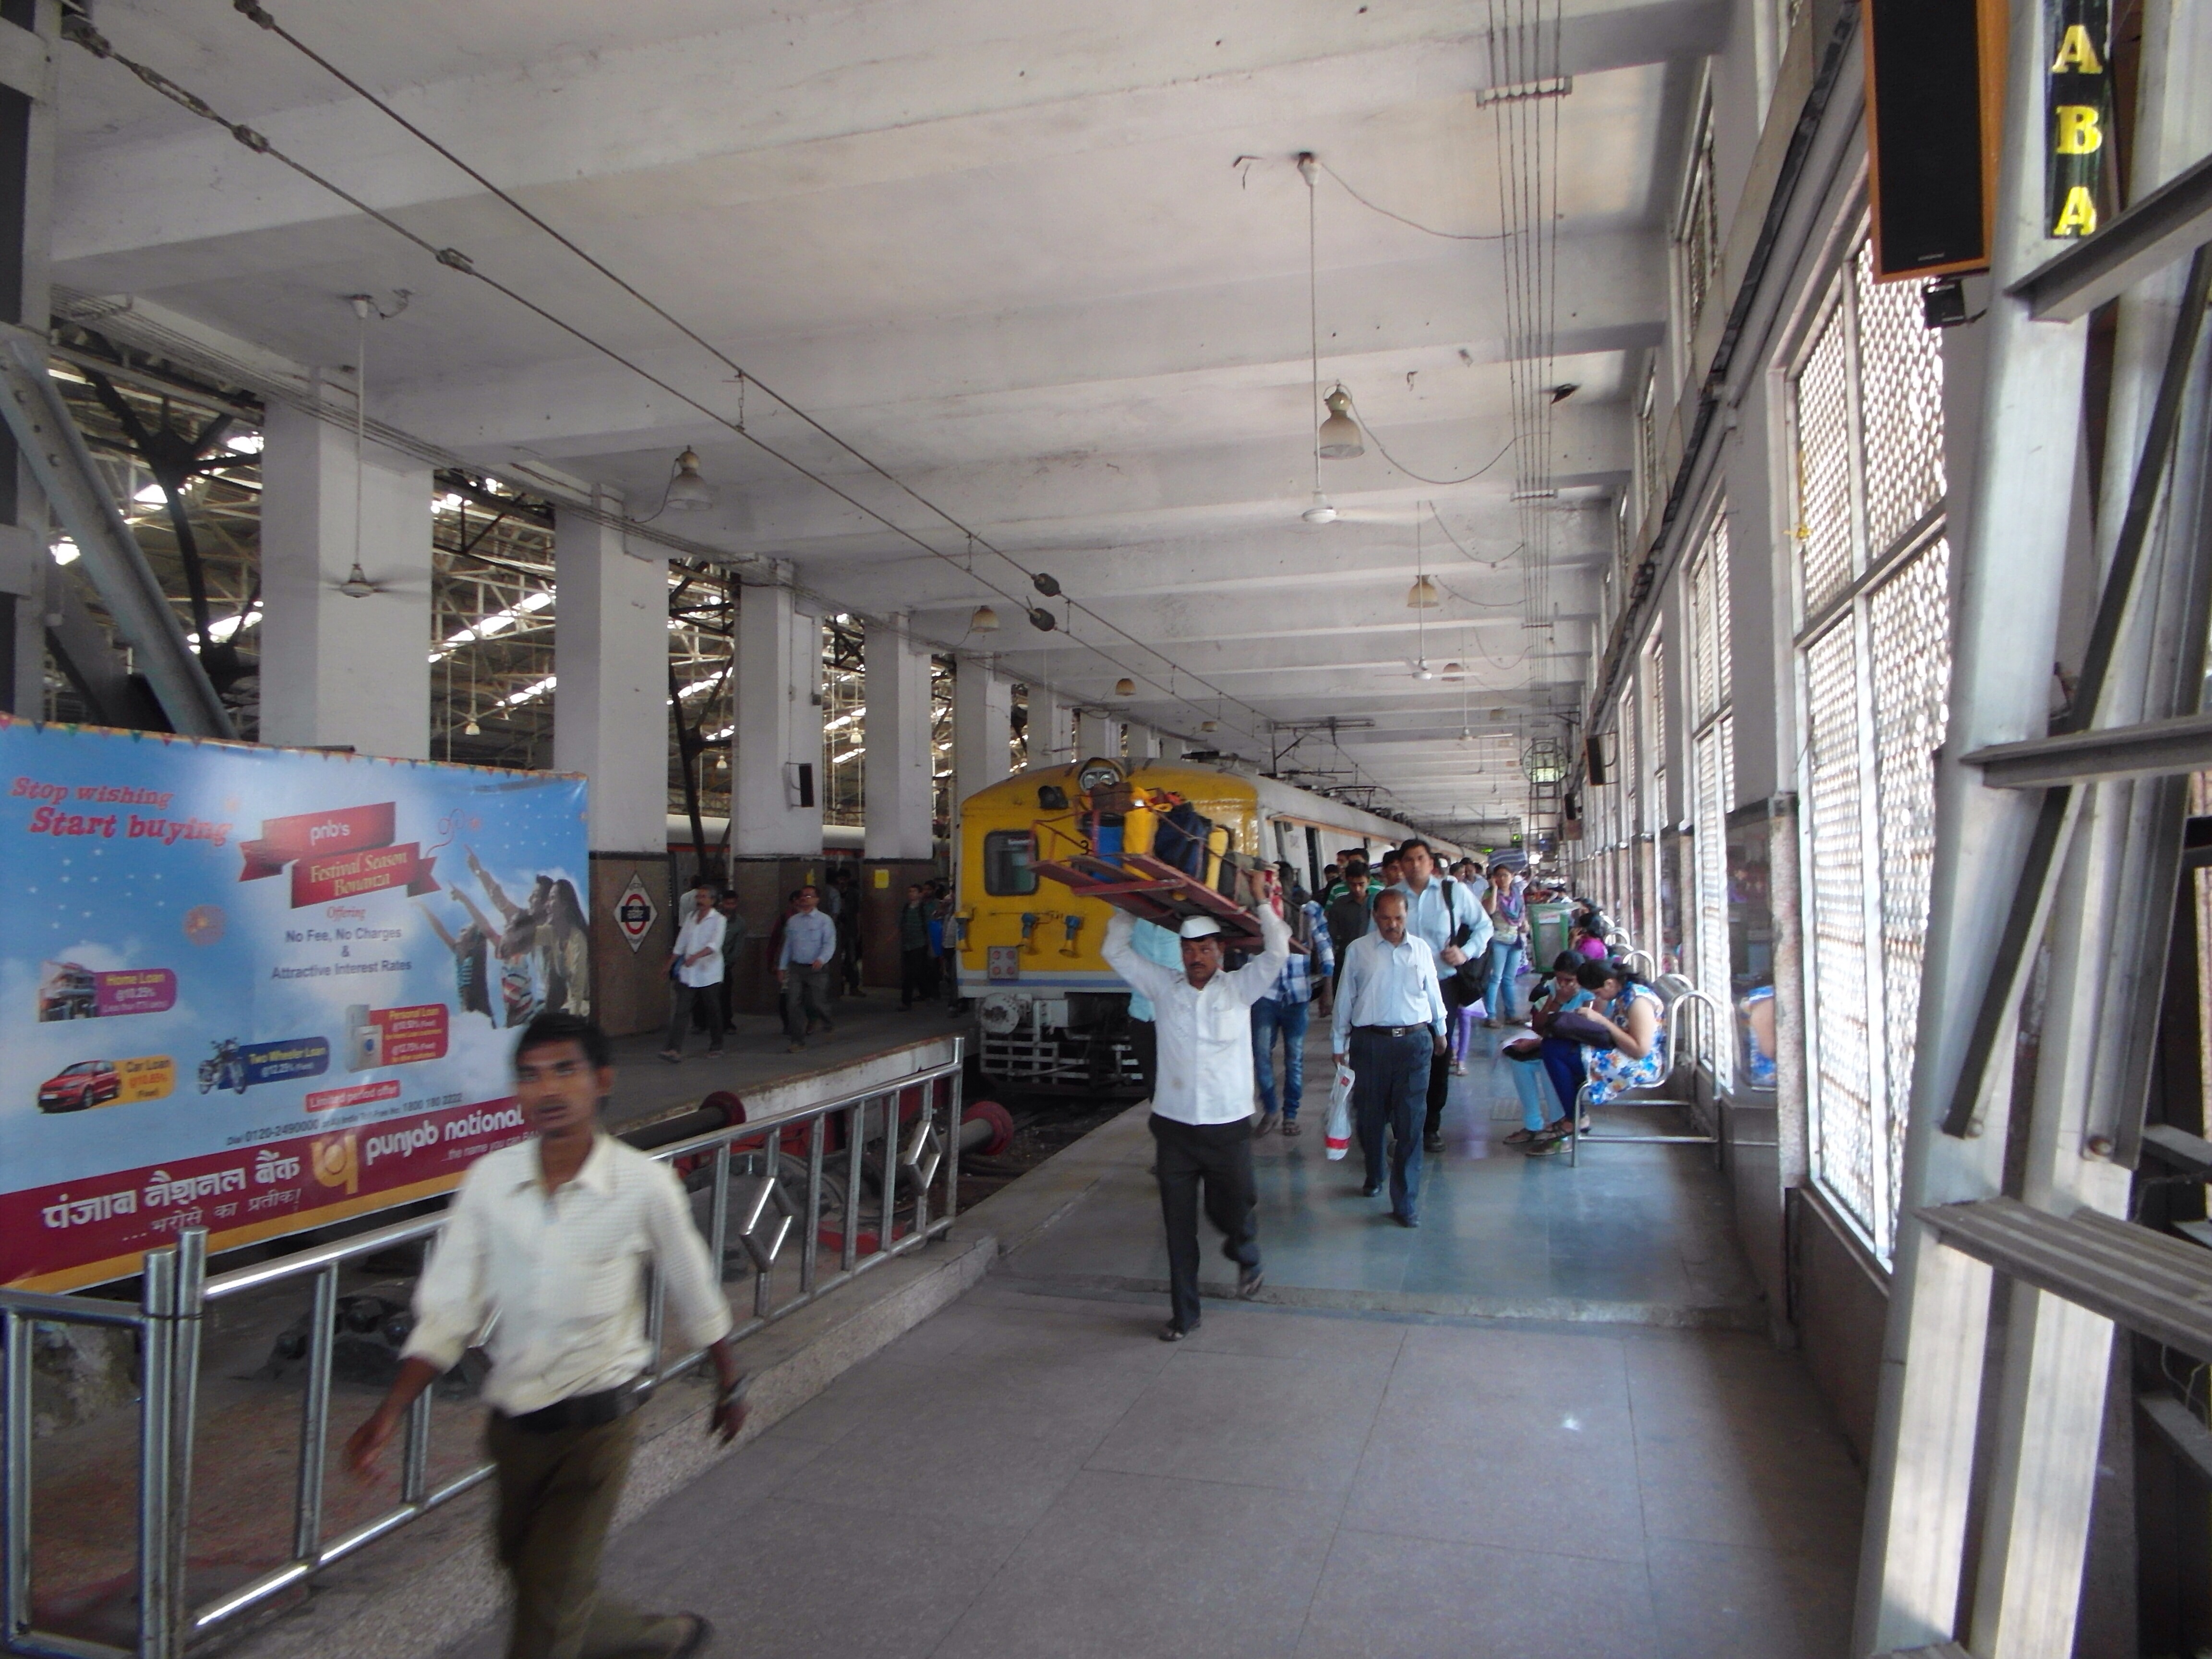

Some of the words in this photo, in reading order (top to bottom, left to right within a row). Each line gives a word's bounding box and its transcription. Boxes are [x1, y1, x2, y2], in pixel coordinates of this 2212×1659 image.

[12, 777, 68, 805] Stop
[77, 786, 173, 810] wishing
[29, 806, 117, 838] Start
[128, 815, 232, 846] buying
[311, 820, 350, 846] pnb's
[311, 853, 362, 883] Festival
[365, 853, 407, 871] Season
[334, 874, 390, 896] Bonanza
[286, 930, 303, 942] No
[307, 929, 332, 942] Fee,
[336, 928, 353, 940] No
[355, 927, 402, 941] Charges
[341, 945, 350, 957] &
[272, 965, 331, 979] Attractive
[335, 962, 378, 975] Interest
[382, 960, 412, 972] Rates
[365, 1120, 439, 1166] punjab
[444, 1104, 525, 1142] national
[42, 1194, 138, 1229] पंजाब
[143, 1170, 247, 1207] नैशनल
[255, 1150, 301, 1184] बैंक
